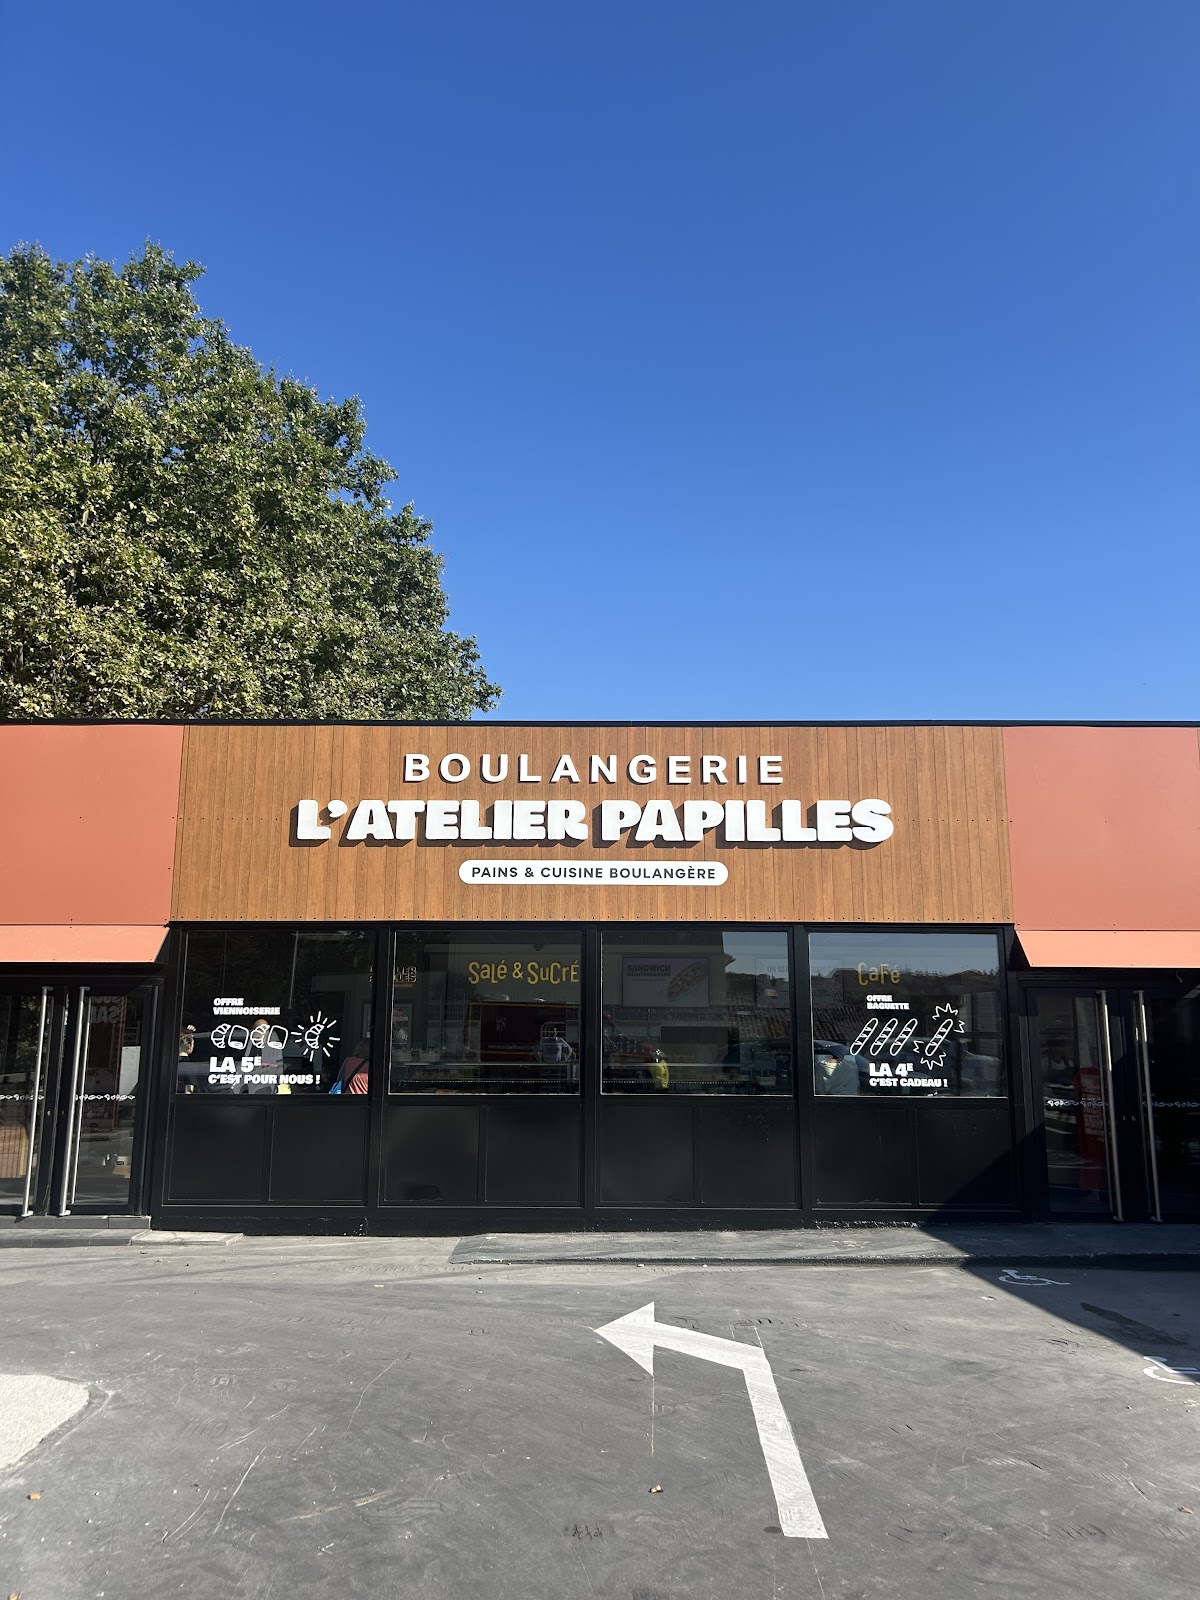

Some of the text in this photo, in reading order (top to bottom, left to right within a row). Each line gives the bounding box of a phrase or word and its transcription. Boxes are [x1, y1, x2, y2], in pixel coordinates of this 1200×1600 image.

[403, 753, 784, 785] BOULANGERIE
[296, 798, 894, 843] L'ATELIER PAPILLES
[471, 865, 716, 879] PAINS & CUISINE BOULANGÈRE
[512, 962, 523, 979] &
[626, 964, 671, 972] SANDWICH
[213, 998, 244, 1006] OFFRE
[213, 1007, 280, 1015] VIENNOISERIE
[209, 1056, 237, 1073] LA
[869, 1063, 893, 1077] LA
[208, 1074, 321, 1085] C'EST POUR NOUS !
[869, 1078, 948, 1087] C'EST CADEAU !
